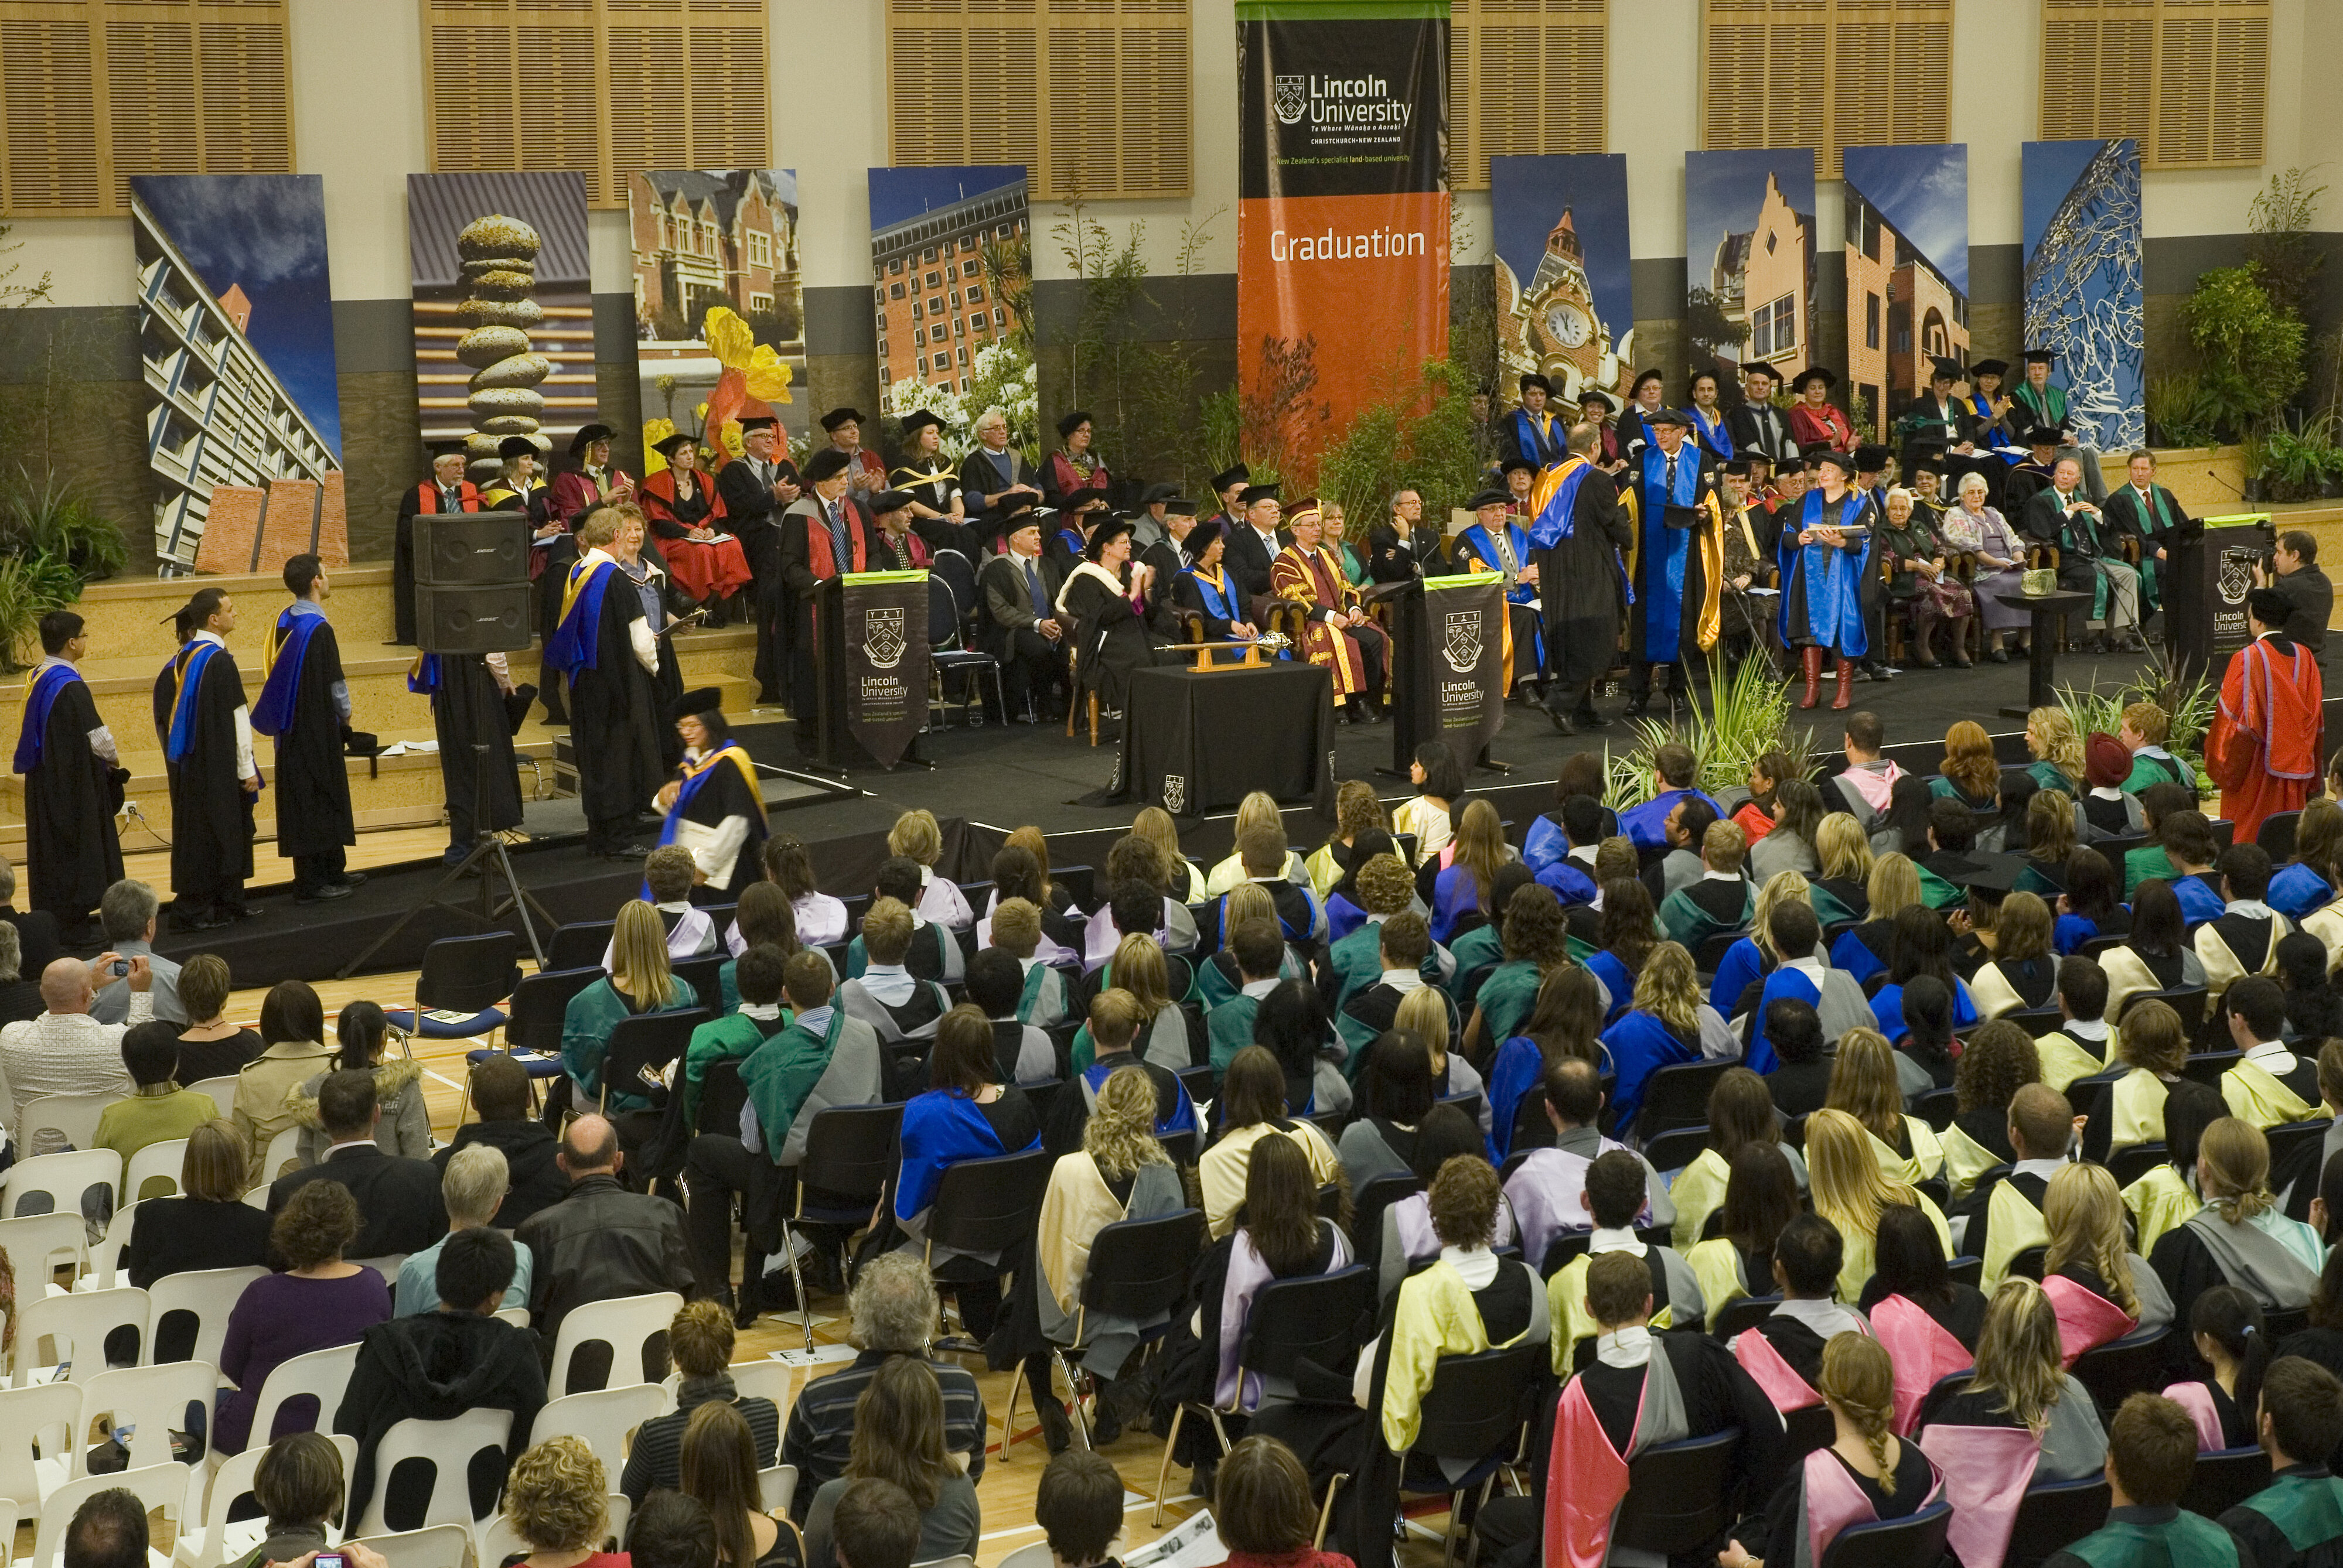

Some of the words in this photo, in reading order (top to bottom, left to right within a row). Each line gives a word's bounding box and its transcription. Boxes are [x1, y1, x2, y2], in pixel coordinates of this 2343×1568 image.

[1311, 74, 1387, 98] Lincoln
[1311, 98, 1412, 127] University
[1291, 156, 1319, 165] Zealand's
[1321, 156, 1348, 165] specialist
[1384, 154, 1410, 162] university
[1271, 226, 1425, 262] Graduation
[2215, 610, 2244, 621] Lincoln
[2214, 620, 2248, 631] Universit
[861, 675, 898, 686] Lincoln
[1442, 679, 1475, 692] Lincoln
[861, 685, 908, 697] University
[1442, 689, 1484, 702] University
[779, 1351, 797, 1359] E
